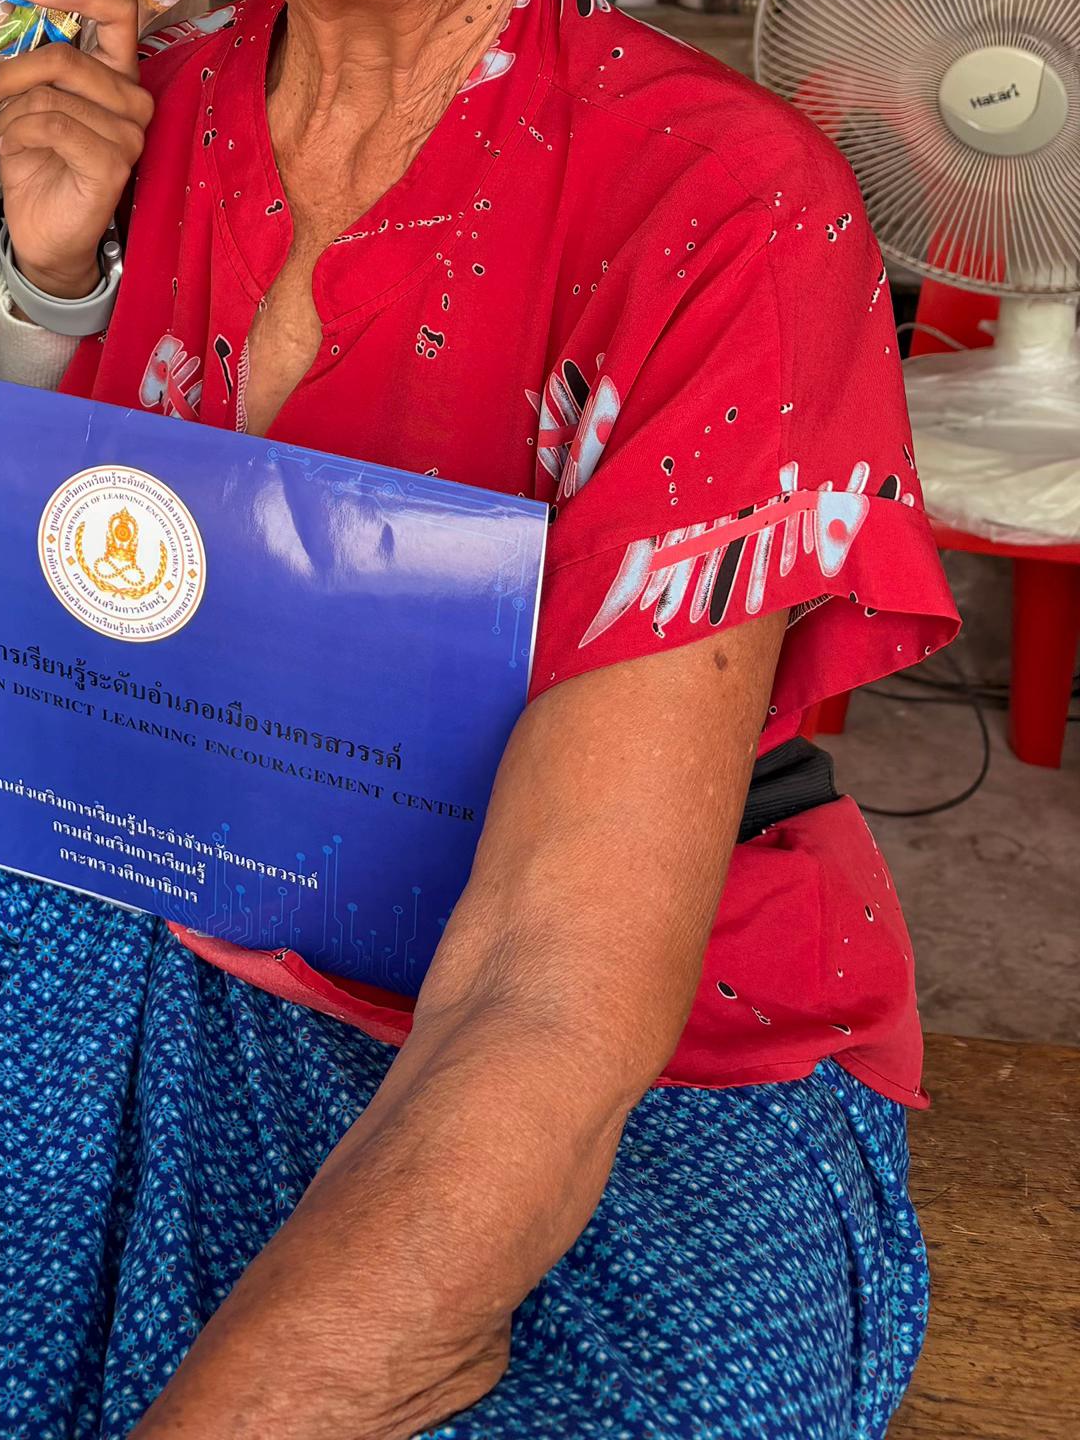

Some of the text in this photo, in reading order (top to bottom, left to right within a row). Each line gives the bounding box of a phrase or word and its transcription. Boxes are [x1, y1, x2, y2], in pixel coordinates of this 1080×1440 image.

[64, 492, 179, 579] DEPARTMENT OF LEARNING ENCOURAGEMENT
[13, 681, 96, 717] DISTRICT
[102, 708, 197, 748] LEARNING
[204, 738, 385, 800] ENCOURAGEMENT
[392, 790, 475, 822] CENTER
[52, 819, 206, 885] กรมส่งเสริมการเรียนรู้
[59, 846, 199, 904] กระทรวงศึกษาธิการ
